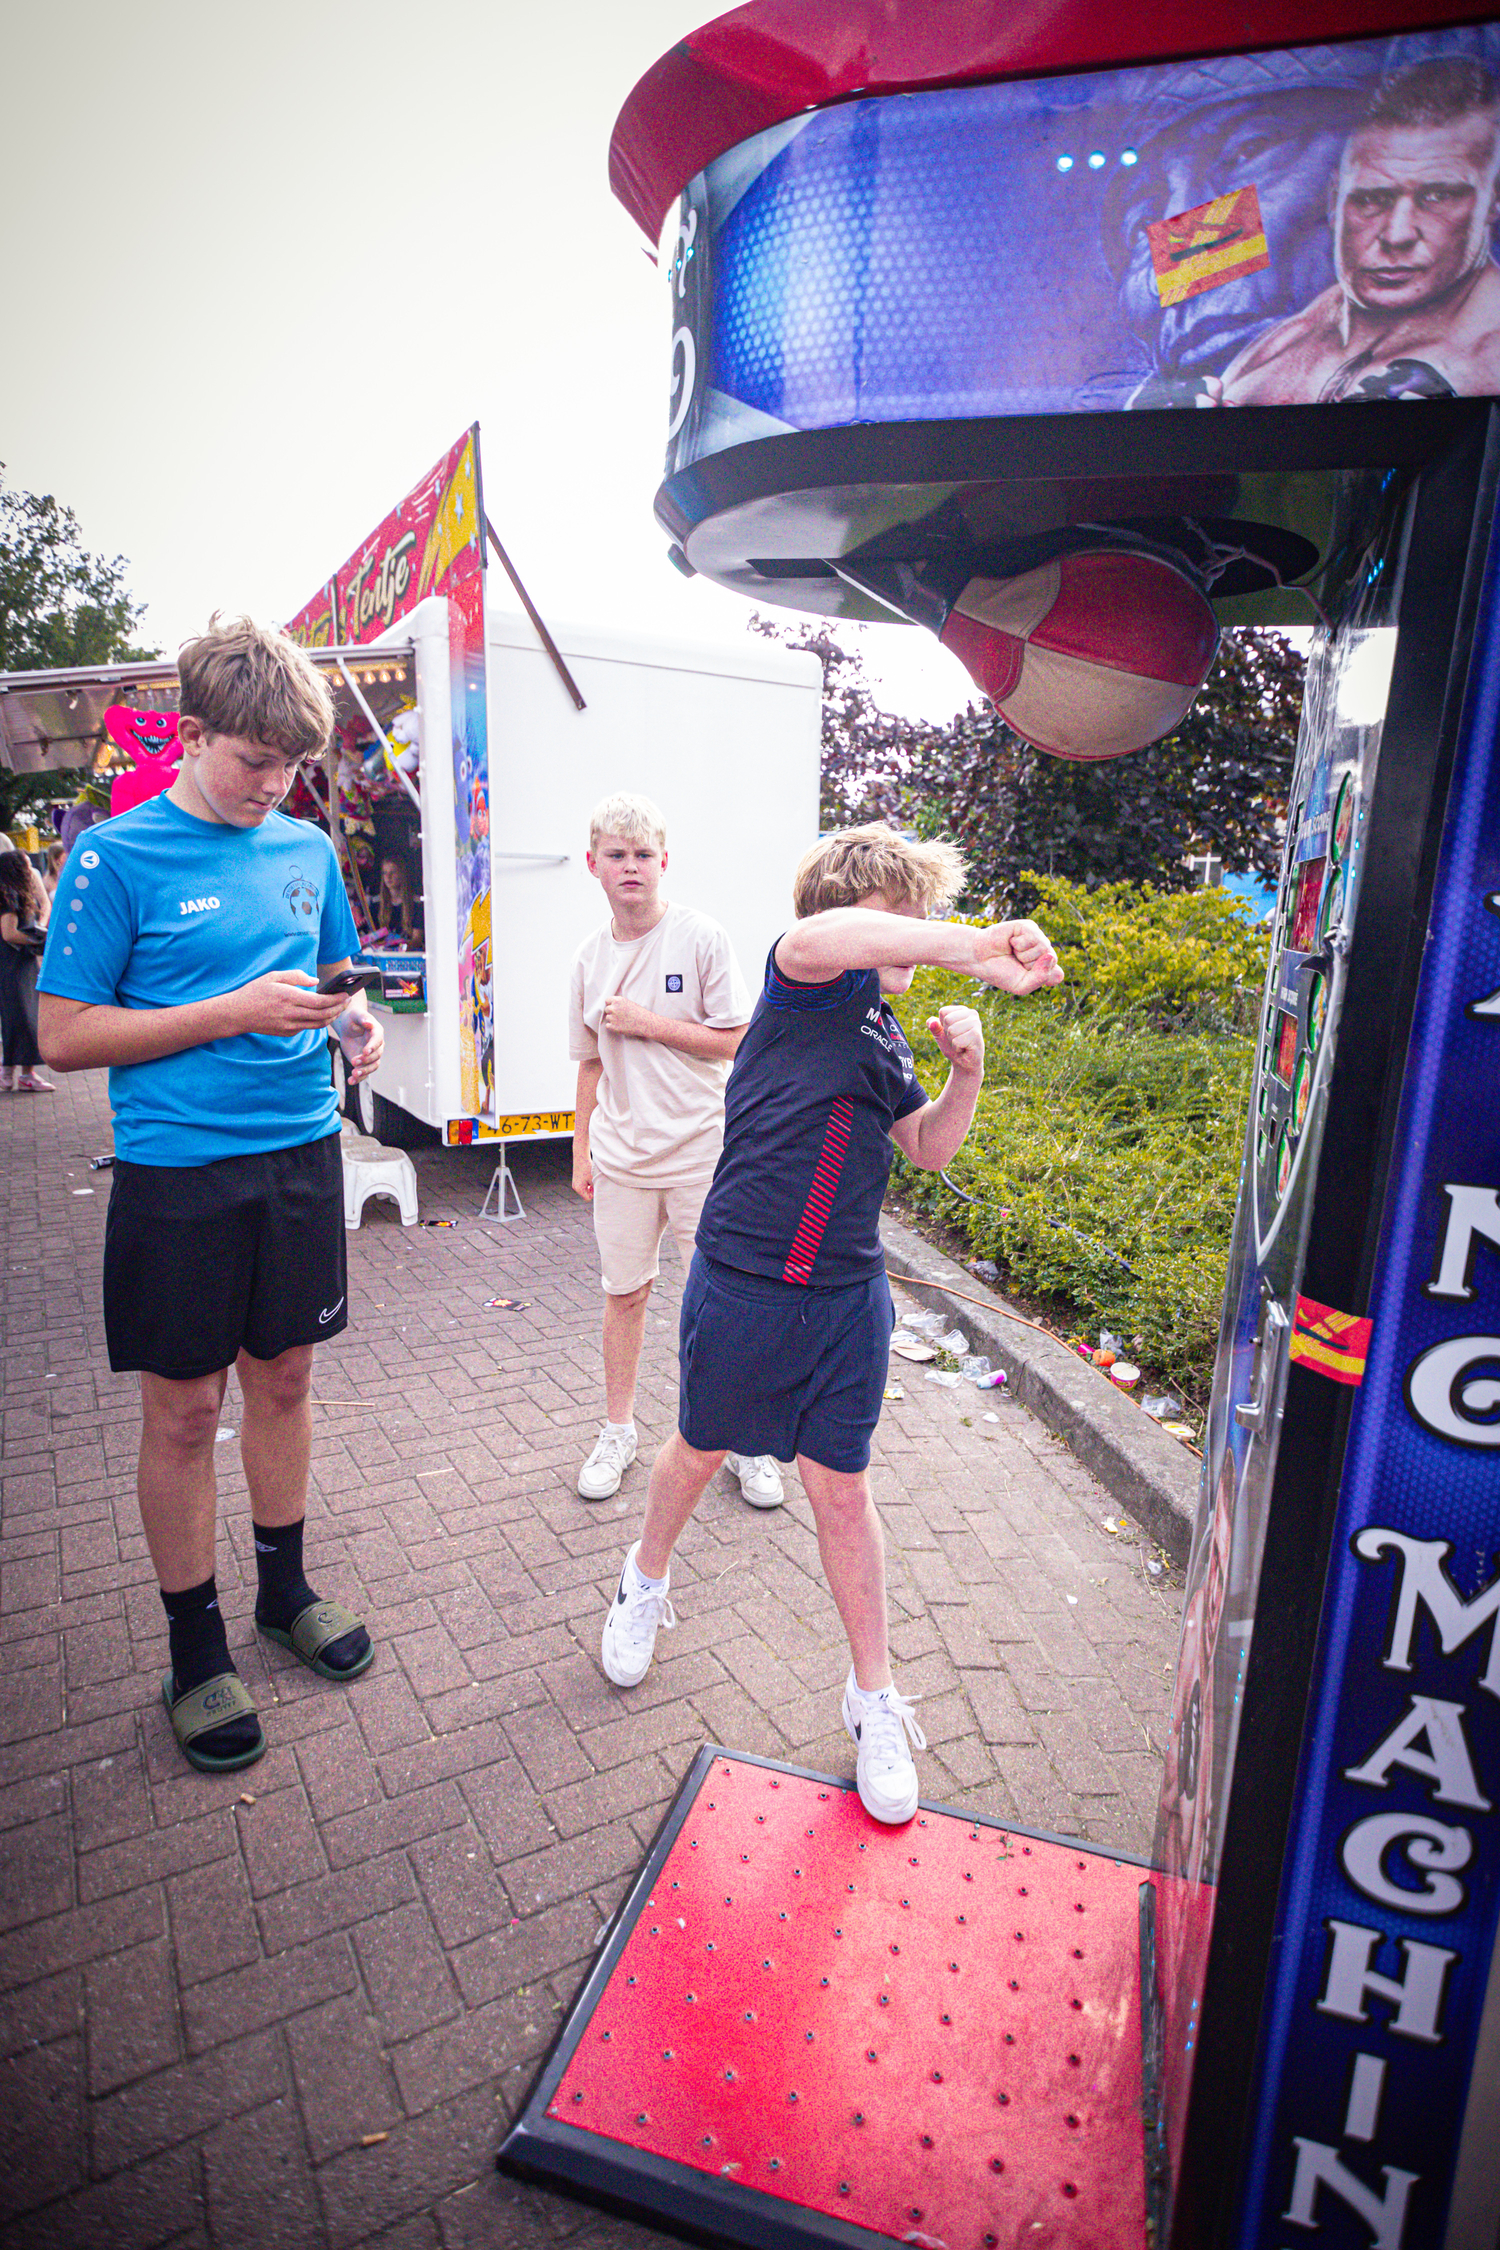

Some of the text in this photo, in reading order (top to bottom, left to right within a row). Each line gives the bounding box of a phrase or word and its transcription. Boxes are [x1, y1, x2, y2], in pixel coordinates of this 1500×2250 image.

[346, 530, 416, 638] Tentje
[180, 897, 221, 915] JAKO
[860, 1025, 893, 1053] ORACLE
